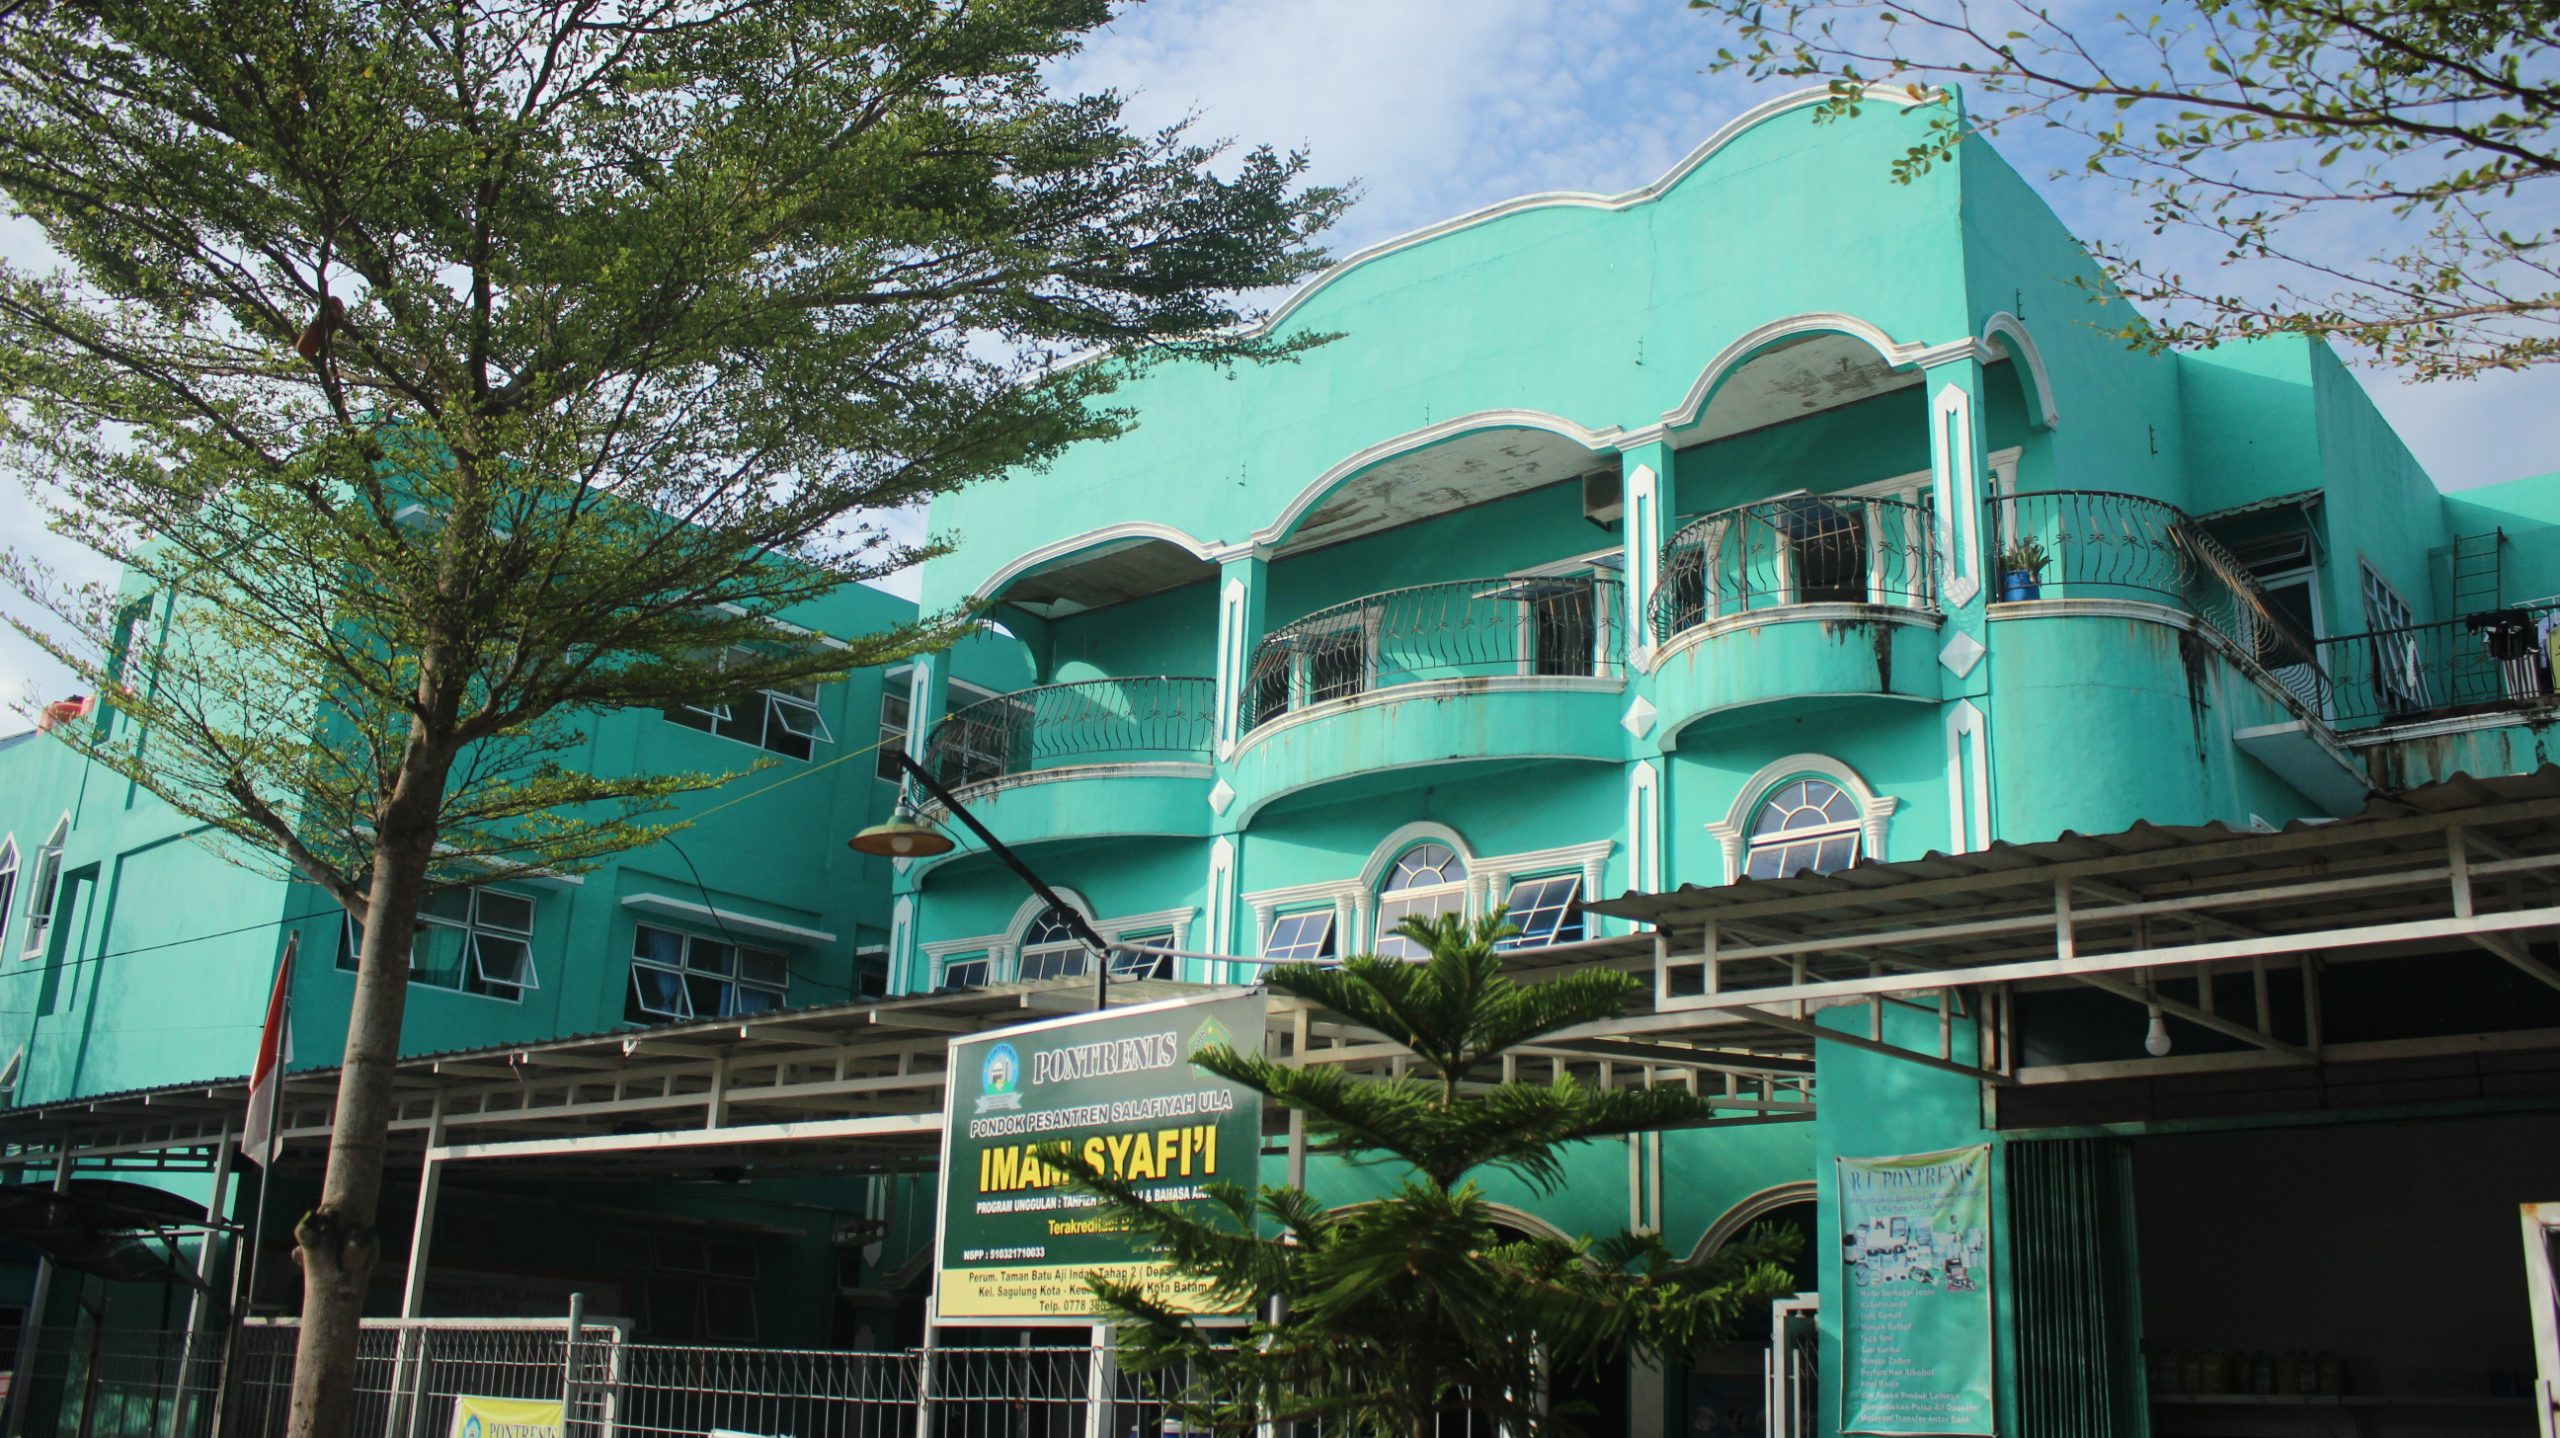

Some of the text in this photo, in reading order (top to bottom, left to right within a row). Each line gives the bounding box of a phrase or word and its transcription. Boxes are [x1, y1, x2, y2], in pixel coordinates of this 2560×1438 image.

[1033, 1031, 1177, 1084] PONTRENIS
[970, 1089, 1233, 1138] PONDOK PESANTREN SALAFIYAH ULA
[1084, 1125, 1217, 1181] SYAFI'I
[1883, 1163, 1974, 1188] PONTRENIS
[976, 1200, 1013, 1214] PROGRAM
[1014, 1197, 1057, 1211] UNGGULAN
[1154, 1186, 1190, 1202] BAHASA
[964, 1249, 984, 1261] NSPP
[969, 1272, 998, 1282] Perum.
[1001, 1270, 1029, 1281] Taman
[1031, 1269, 1053, 1281] Batu
[1055, 1268, 1067, 1282] Aji
[1098, 1266, 1128, 1281] Tahap
[979, 1286, 995, 1297] Kel.
[998, 1284, 1037, 1299] Sagulung
[1040, 1285, 1061, 1296] Kota
[1147, 1281, 1170, 1294] Kota
[1040, 1300, 1061, 1314] Telp.
[1063, 1299, 1086, 1311] 0778
